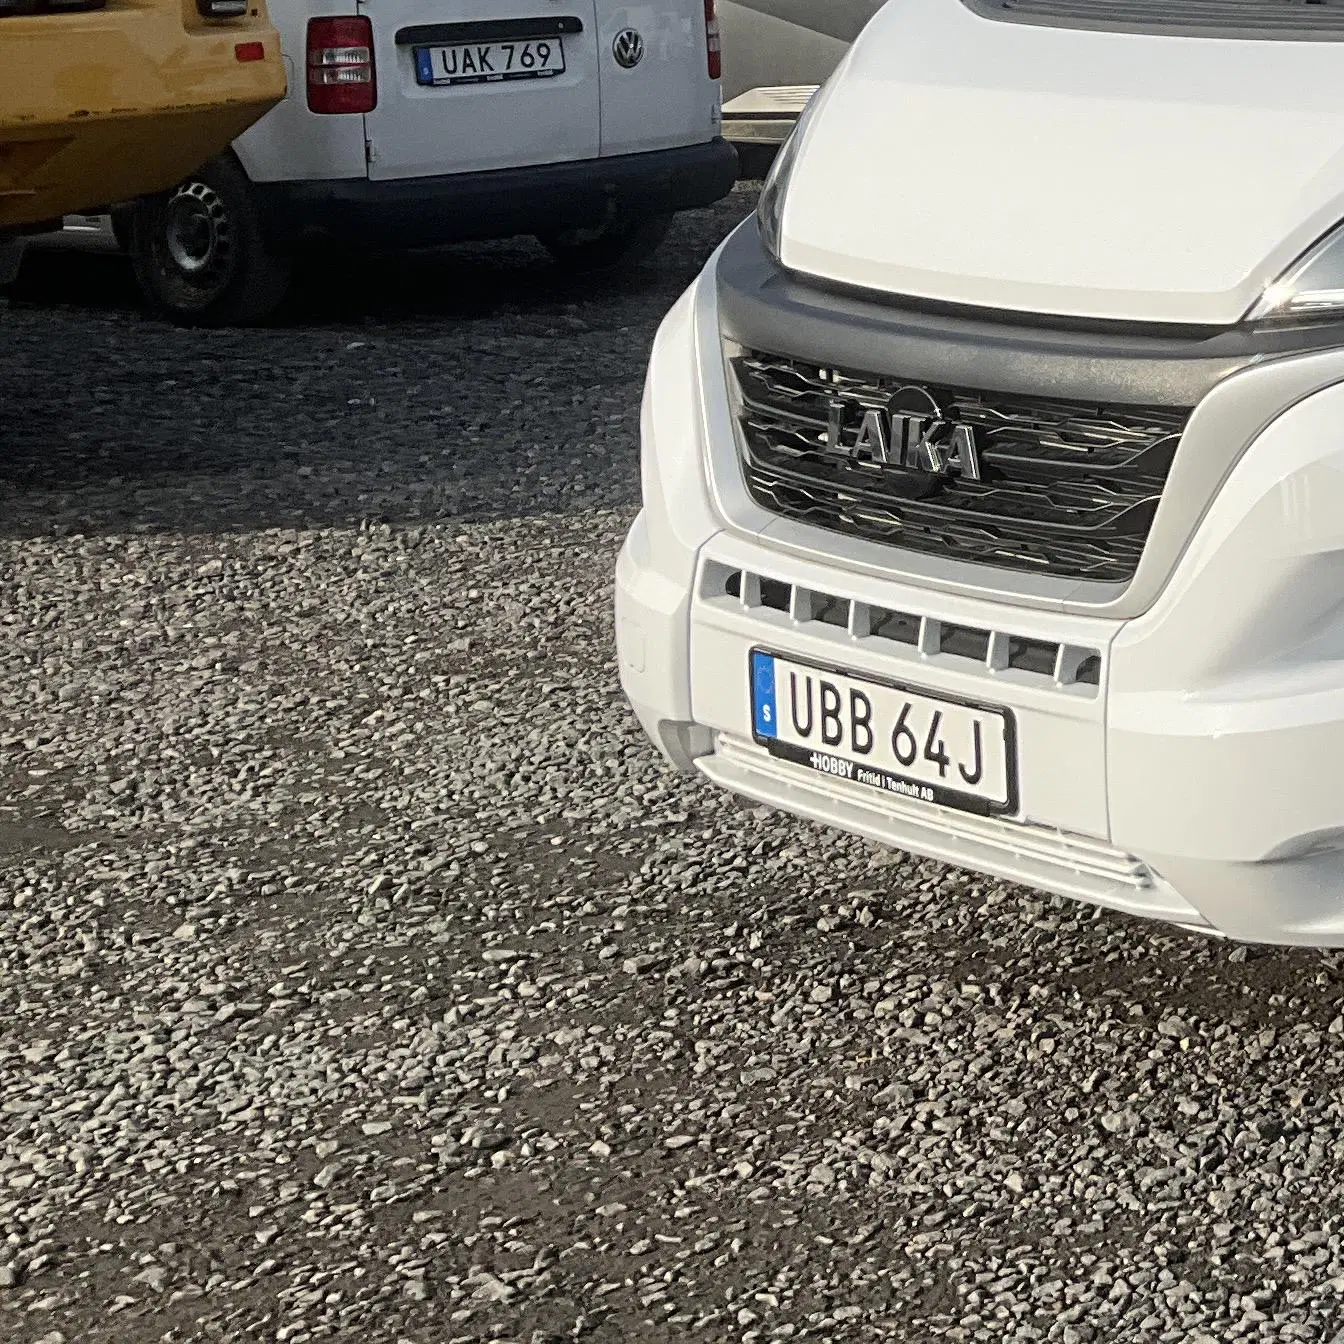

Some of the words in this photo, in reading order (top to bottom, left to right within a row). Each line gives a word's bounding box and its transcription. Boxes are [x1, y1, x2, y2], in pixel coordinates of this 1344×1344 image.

[441, 46, 495, 75] UAK
[501, 43, 551, 70] 769
[826, 402, 981, 481] LAIKA
[763, 704, 771, 722] S
[790, 671, 874, 755] UBB
[891, 702, 984, 785] 64J
[810, 752, 854, 778] HOBBY
[920, 786, 934, 801] AB
